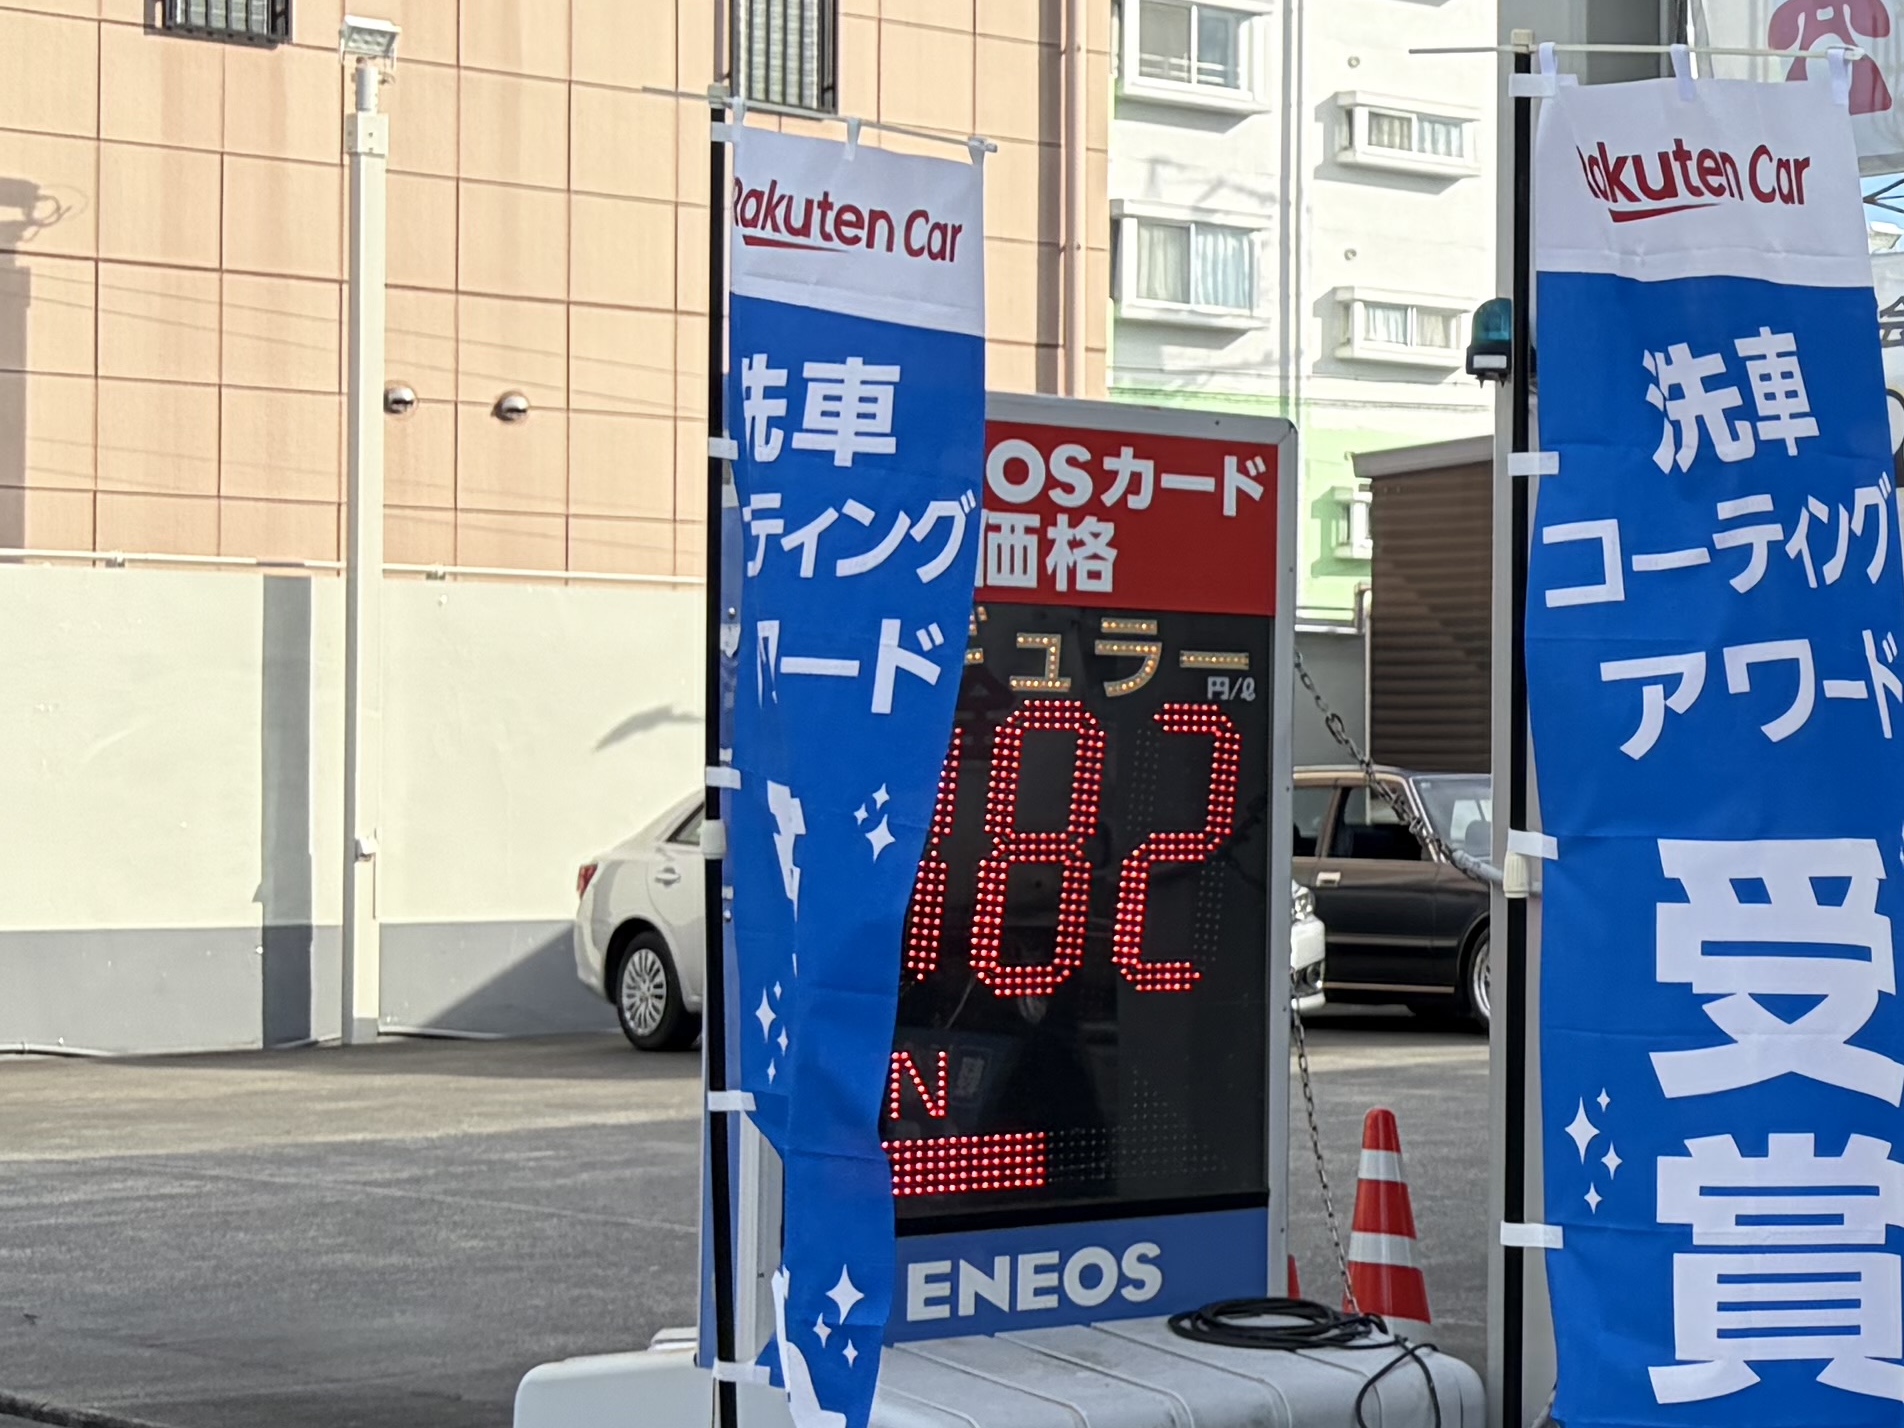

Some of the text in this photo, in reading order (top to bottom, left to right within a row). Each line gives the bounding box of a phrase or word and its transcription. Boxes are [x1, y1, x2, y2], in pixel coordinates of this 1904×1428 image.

[1576, 138, 1810, 205] akuten Car
[904, 209, 963, 263] Car
[1642, 326, 1820, 475] 洗車
[974, 509, 1118, 593] 価格
[1542, 472, 1891, 608] コーティング
[1601, 628, 1903, 761] アワード
[905, 699, 1242, 997] 182
[906, 1241, 1162, 1324] ENEOS
